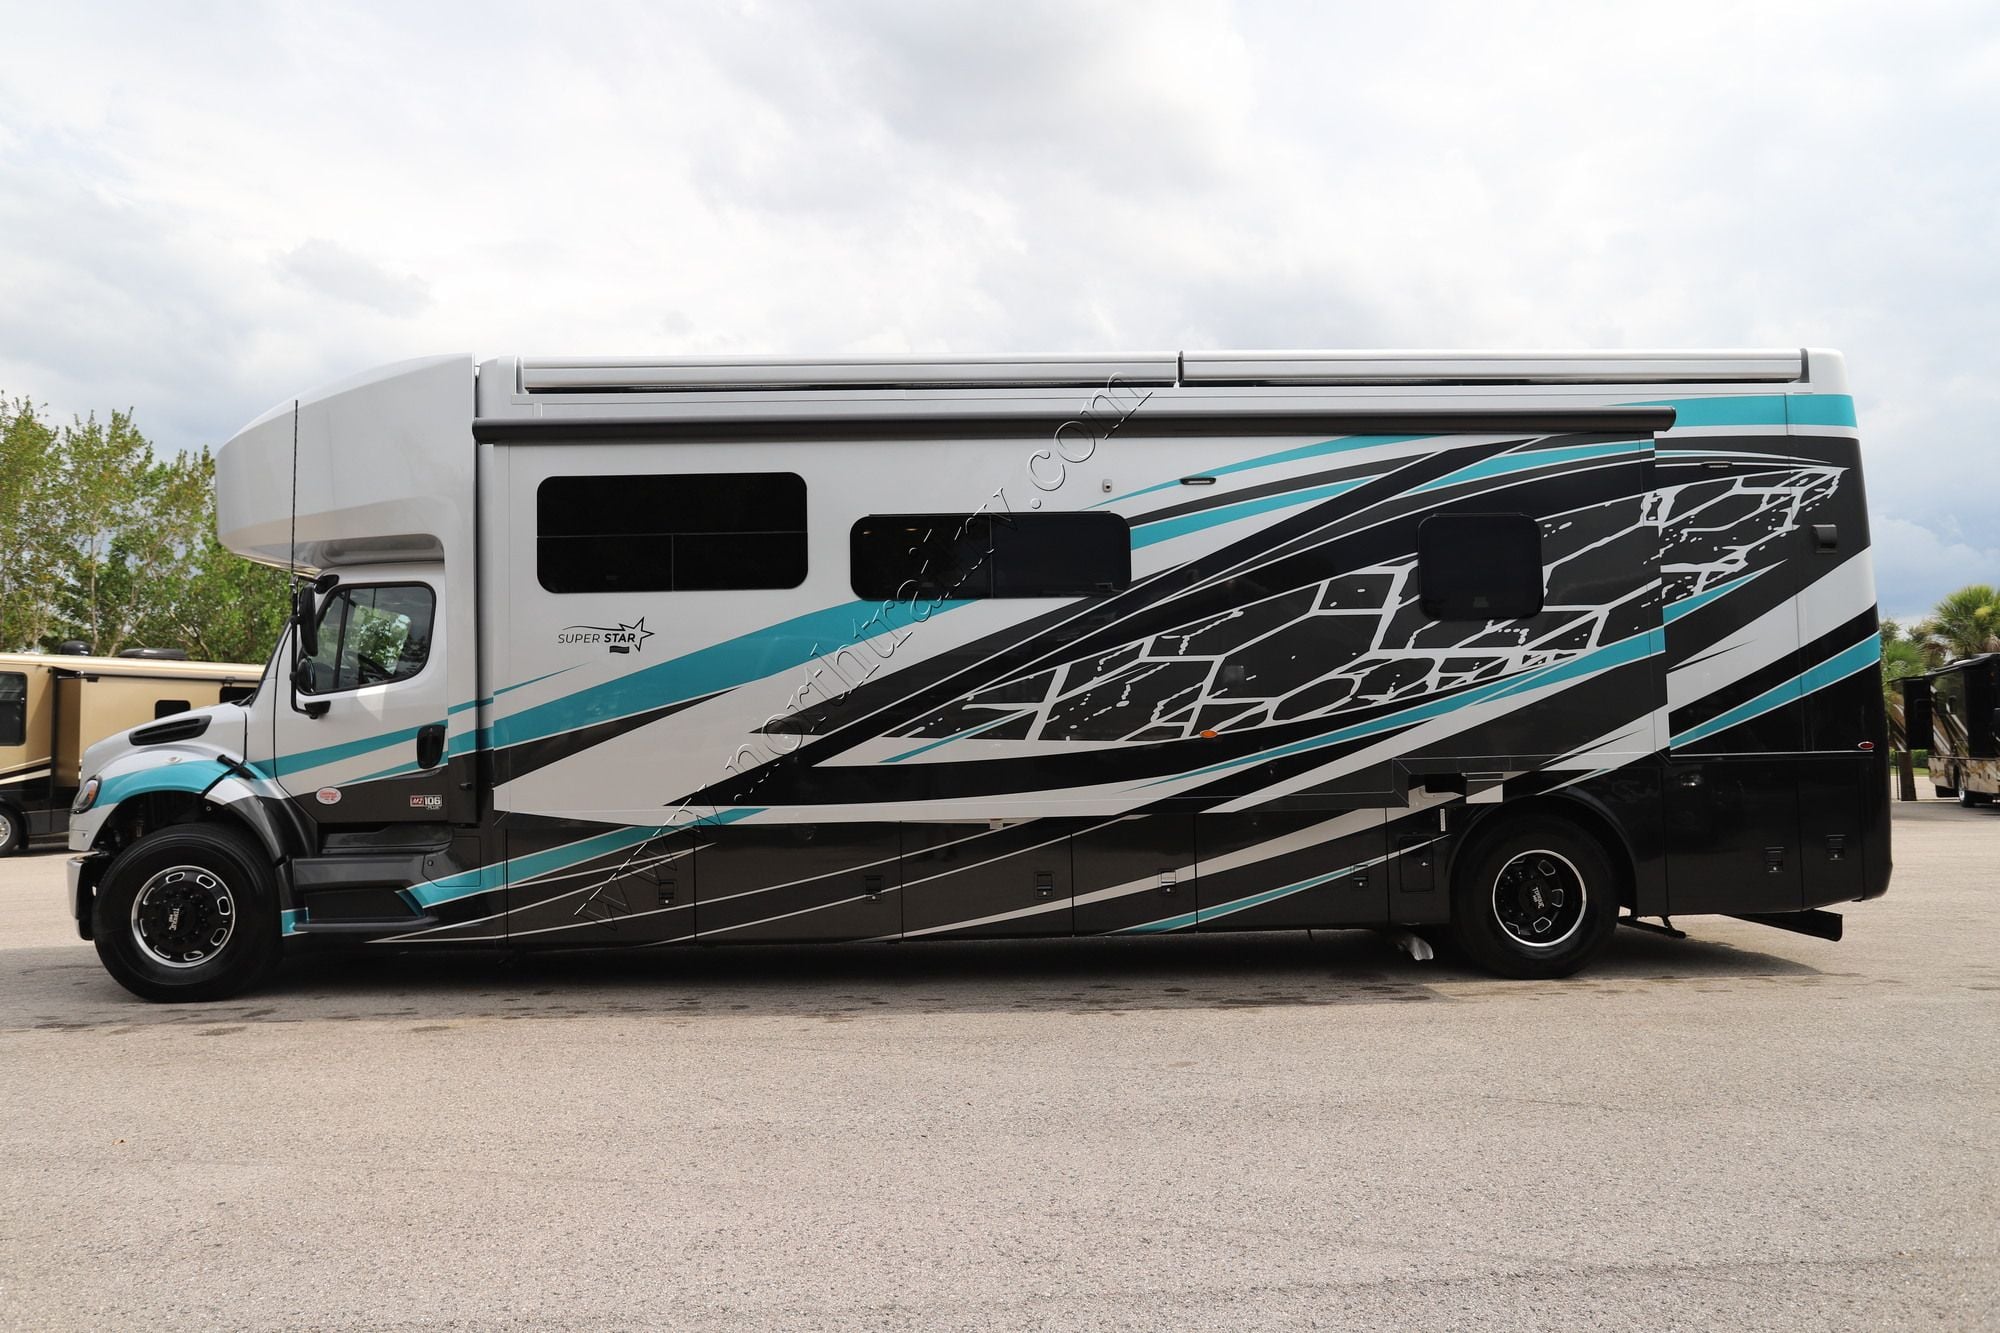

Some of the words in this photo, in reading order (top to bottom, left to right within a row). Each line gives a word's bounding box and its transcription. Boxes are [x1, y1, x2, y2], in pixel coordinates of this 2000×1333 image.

[558, 633, 600, 644] SUPER
[604, 633, 636, 643] STAR
[424, 796, 441, 805] 106
